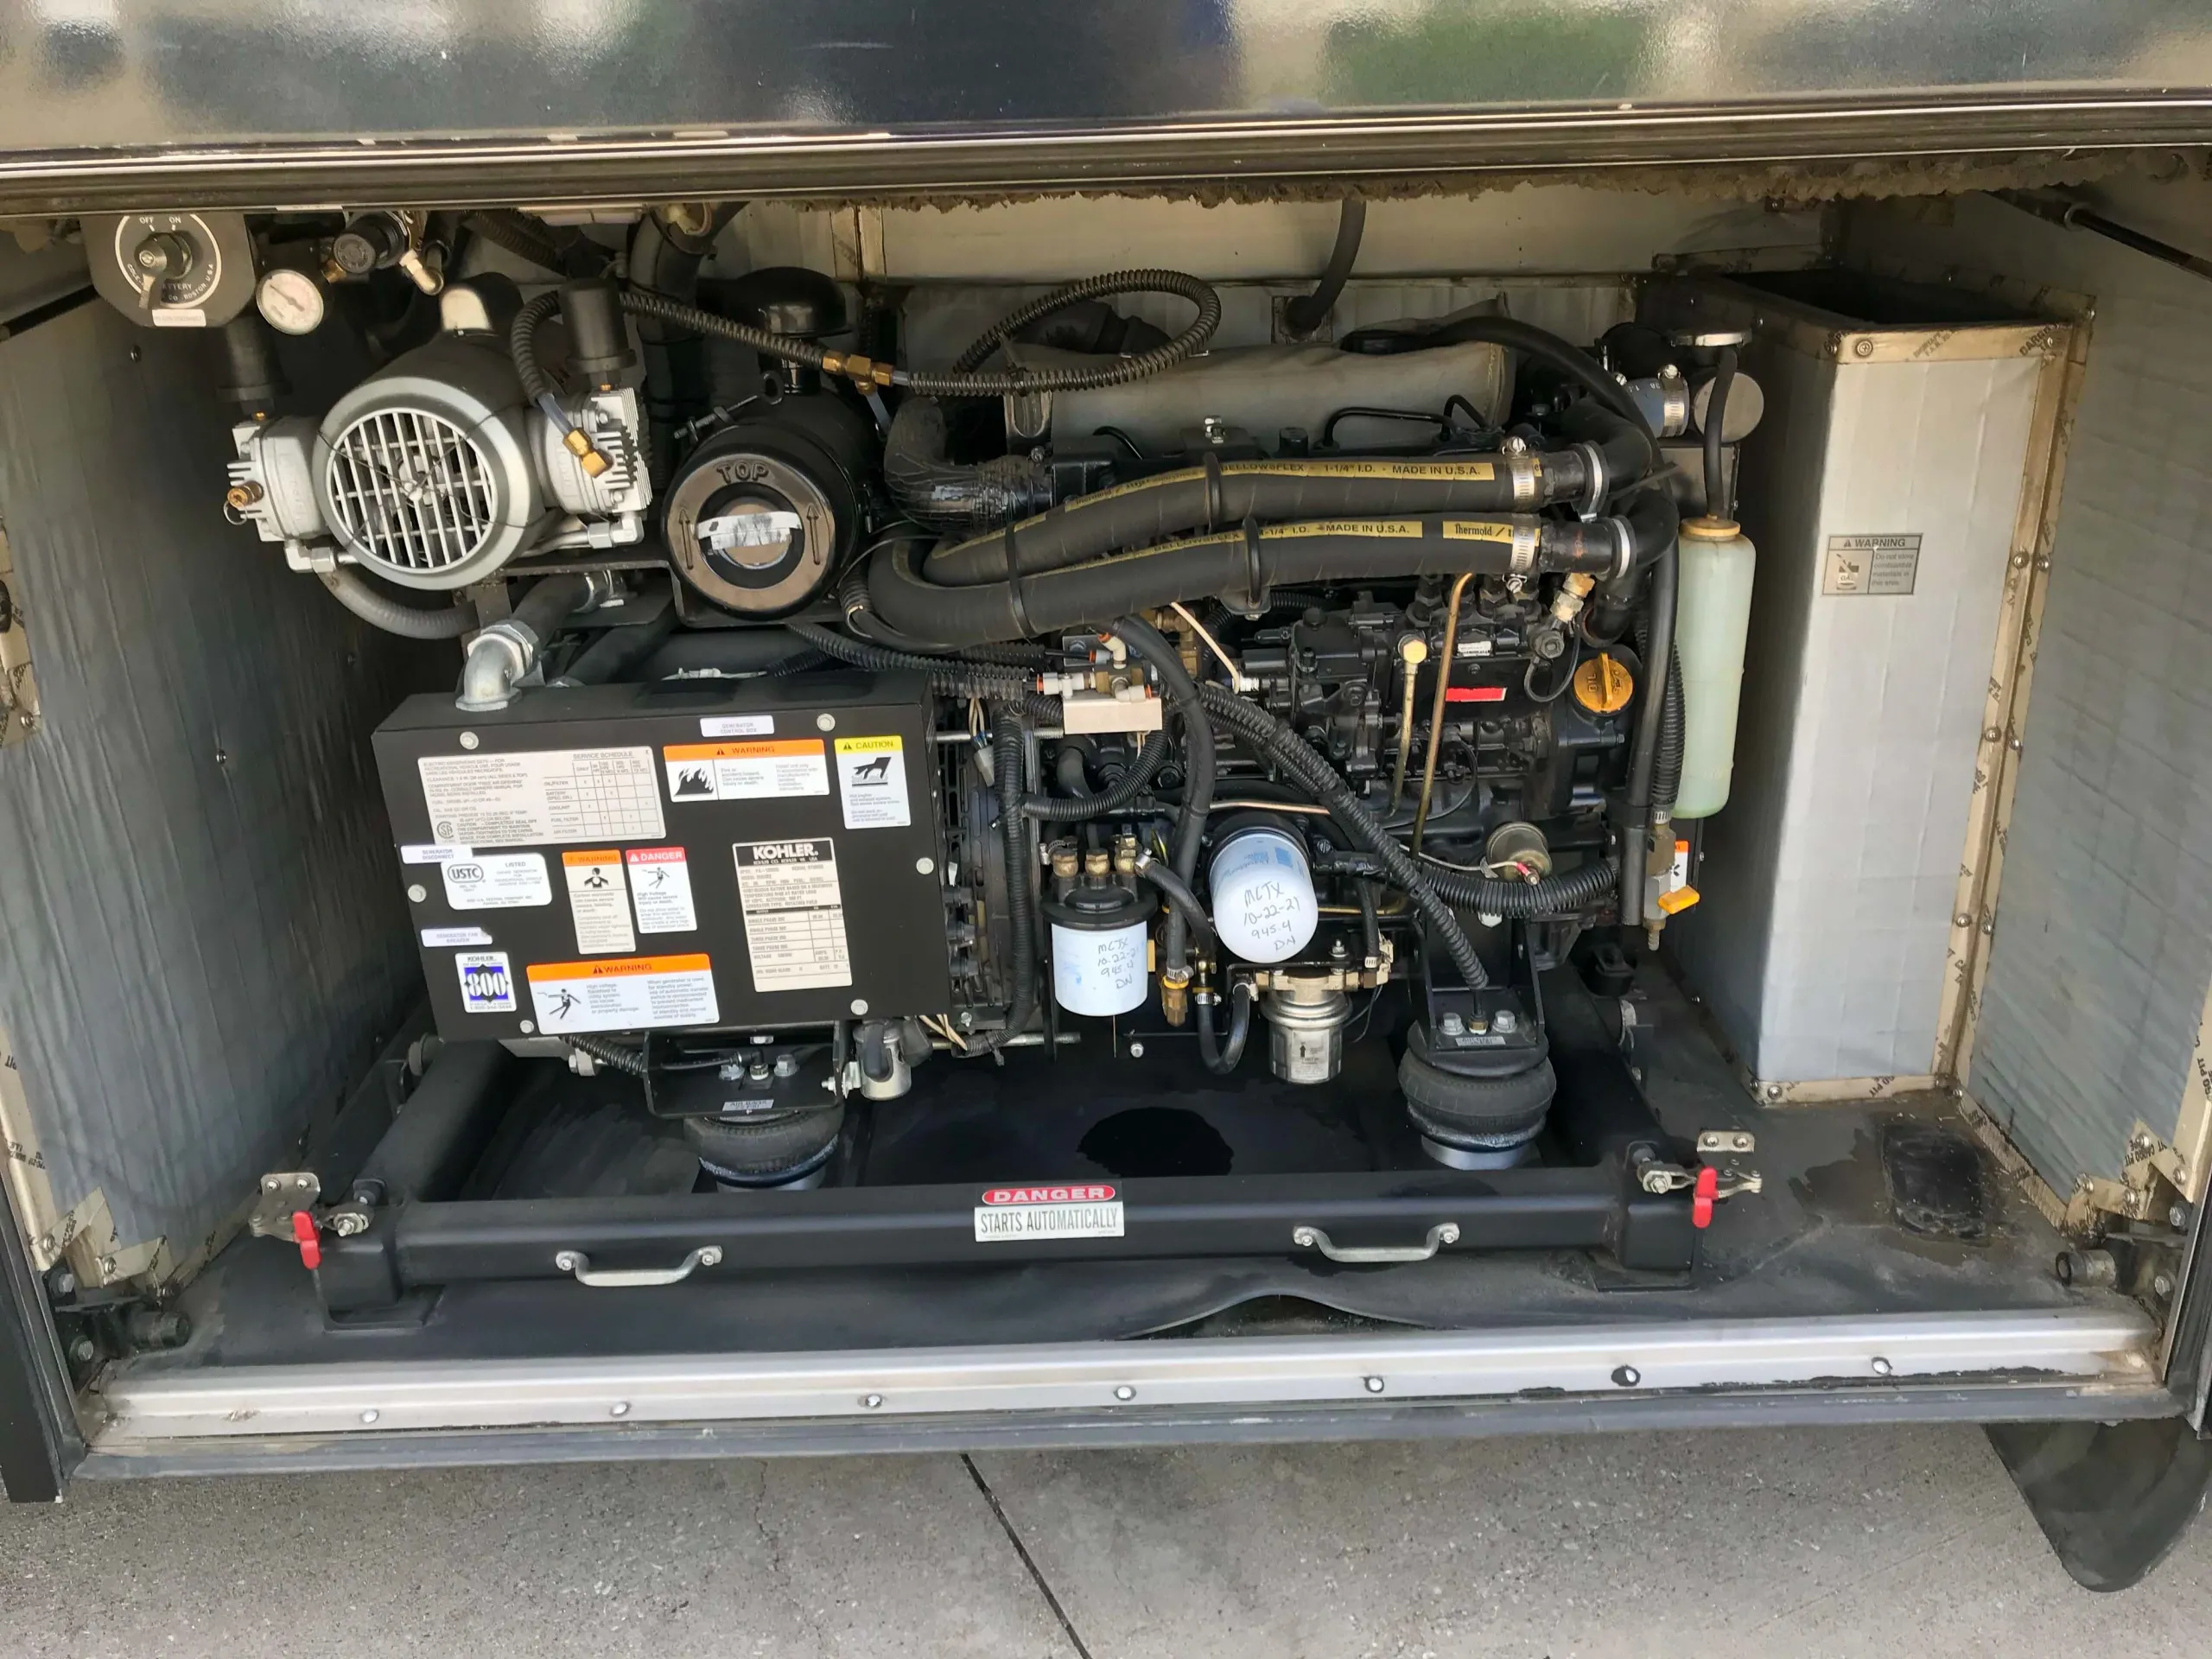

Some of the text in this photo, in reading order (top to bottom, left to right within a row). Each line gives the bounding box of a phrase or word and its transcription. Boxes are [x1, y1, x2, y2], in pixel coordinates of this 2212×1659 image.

[715, 462, 770, 484] TOP
[1392, 465, 1427, 474] MADE
[1430, 466, 1441, 474] IN
[1446, 466, 1481, 475] U.S.A.
[1325, 524, 1358, 532] MADE
[1376, 524, 1410, 533] U.S.A.
[1455, 523, 1492, 536] Thermoid
[1855, 538, 1905, 548] WARNING
[1588, 673, 1597, 692] OIL
[855, 741, 893, 749] CAUTION
[640, 852, 682, 861] DANGER
[753, 842, 819, 860] KOHLER.
[452, 868, 478, 880] USTC
[1244, 880, 1285, 908] MCTX
[1244, 896, 1300, 926] 10-22-21
[1251, 919, 1292, 939] 945.4
[1098, 937, 1128, 955] MCTX
[1274, 935, 1296, 954] DN
[604, 964, 652, 974] WARNING
[467, 972, 506, 996] 800
[1116, 973, 1133, 989] DN
[994, 1187, 1105, 1202] DANGER
[981, 1207, 1118, 1234] STARTS AUTOMATICALLY
